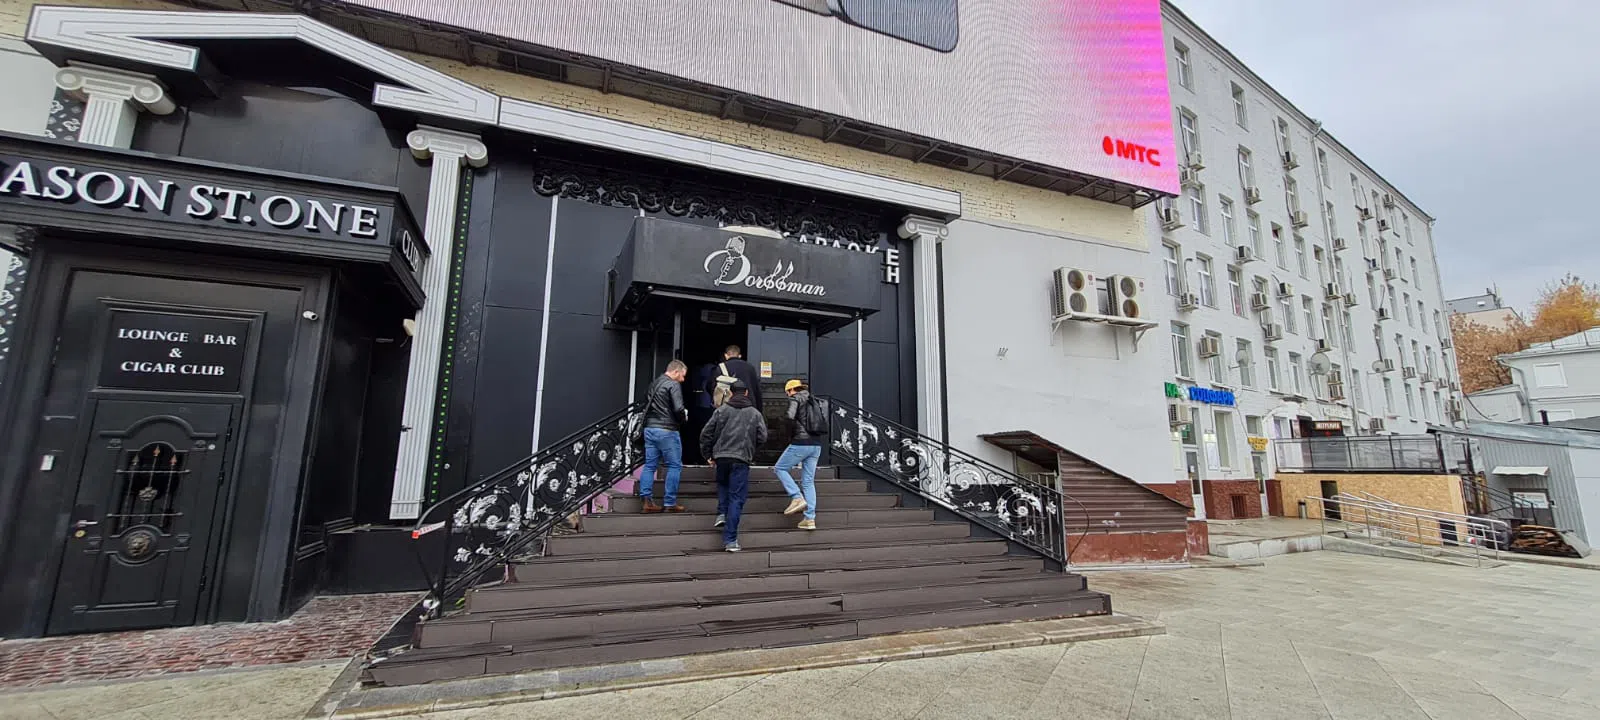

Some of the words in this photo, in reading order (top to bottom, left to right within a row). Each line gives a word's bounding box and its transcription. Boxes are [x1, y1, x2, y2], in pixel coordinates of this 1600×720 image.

[1116, 139, 1161, 167] МТС
[402, 229, 420, 273] CLUB
[117, 327, 190, 343] LOUNGE
[203, 333, 238, 346] BAR
[168, 347, 183, 358] &
[120, 360, 177, 374] CIGAR
[180, 363, 226, 376] CLUB
